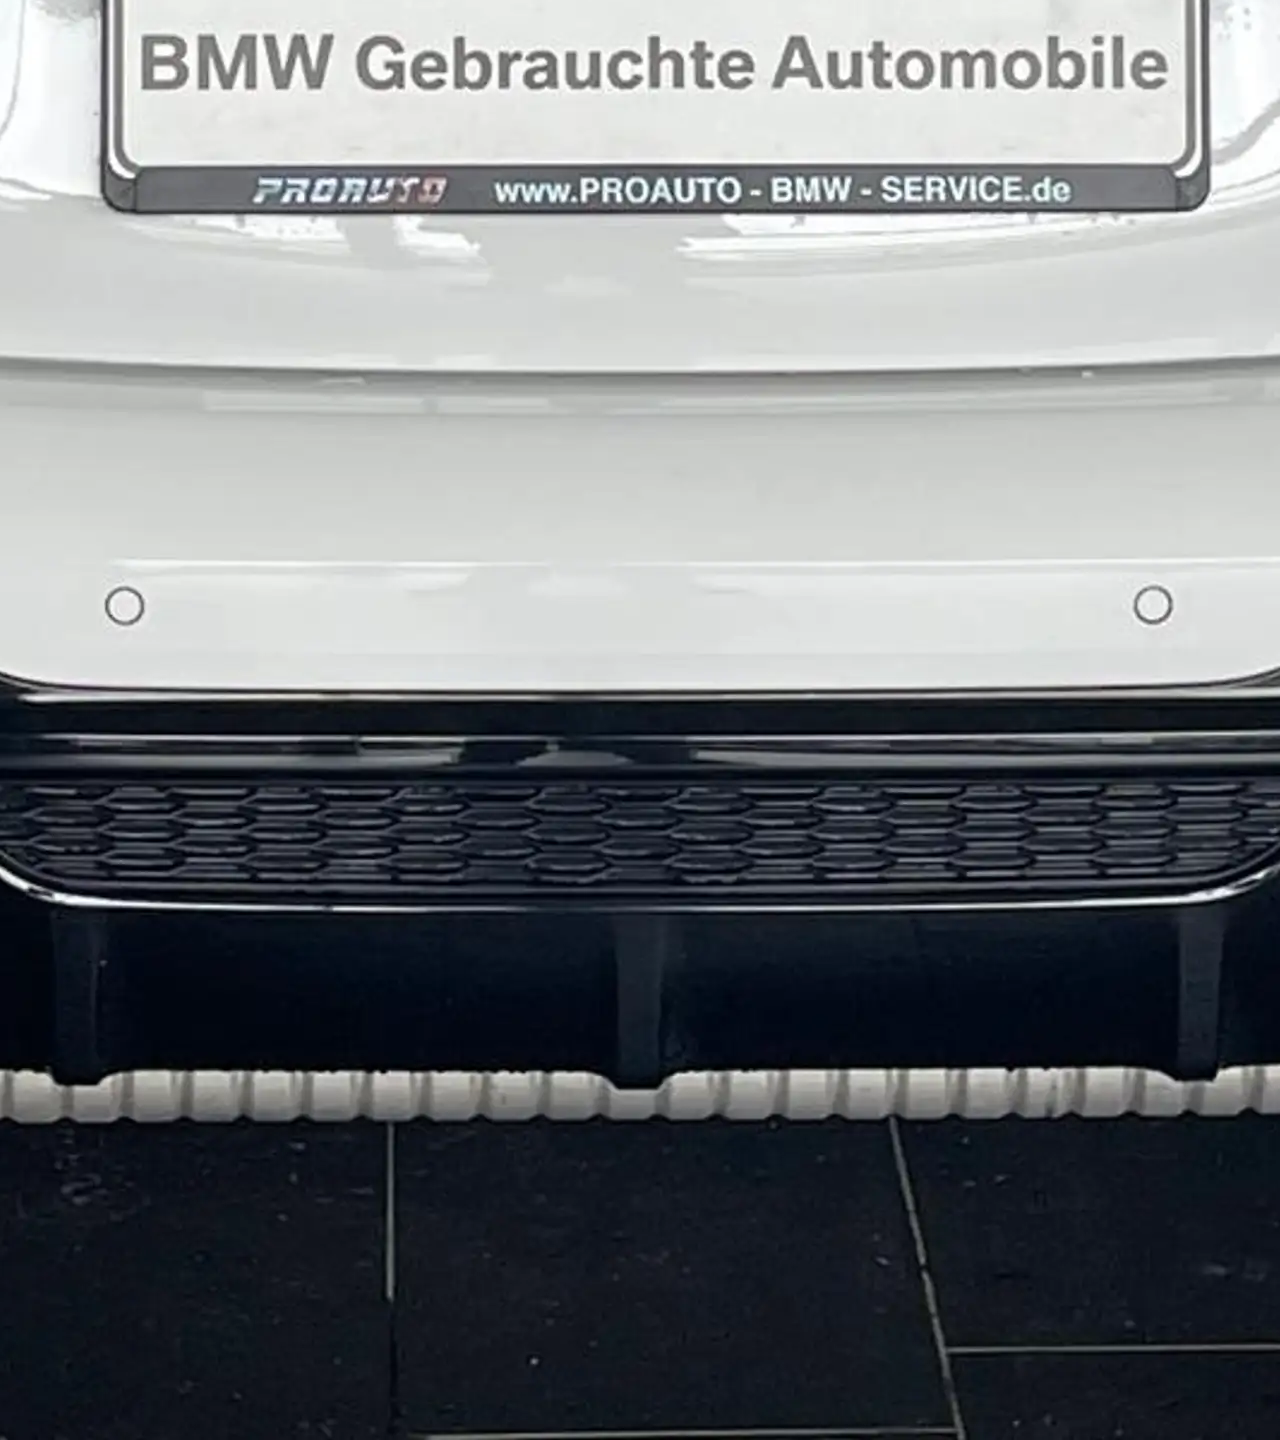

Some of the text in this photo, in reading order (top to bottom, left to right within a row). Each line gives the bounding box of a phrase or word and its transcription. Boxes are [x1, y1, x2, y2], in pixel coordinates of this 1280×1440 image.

[140, 34, 1169, 91] BMW Gebrauchte Automobile
[253, 177, 448, 204] PROAUTO
[495, 175, 743, 205] www.PROAUTO
[770, 175, 852, 203] BMW
[881, 175, 1072, 203] SERVICE.de
